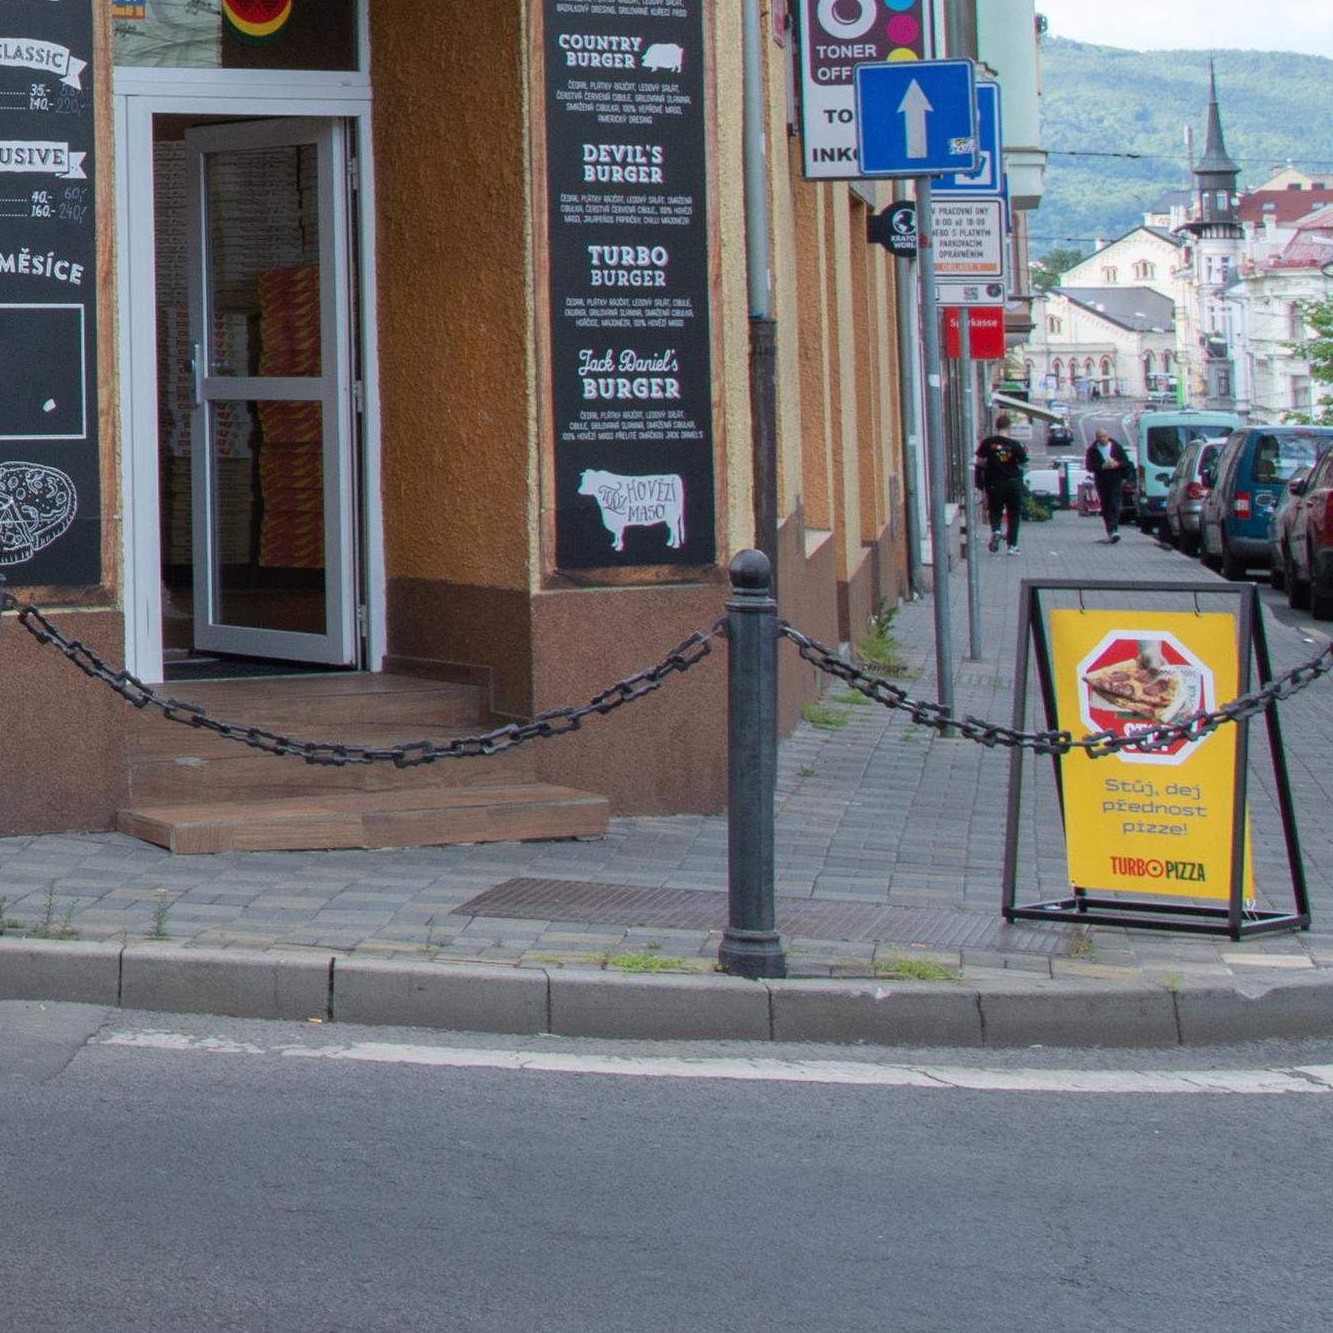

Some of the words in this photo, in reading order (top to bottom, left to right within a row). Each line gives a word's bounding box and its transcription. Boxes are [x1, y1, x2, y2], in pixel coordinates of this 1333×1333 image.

[557, 33, 643, 53] COUNTRY
[815, 43, 878, 59] TONER
[565, 51, 637, 69] BURGER
[582, 143, 664, 165] DEVIL'S
[583, 165, 664, 185] BURGER
[938, 206, 973, 216] PRACOVNÍ
[974, 207, 990, 216] DNY
[890, 234, 916, 242] KRATO
[587, 245, 669, 268] TURBO
[590, 269, 667, 288] BURGER
[949, 317, 998, 328] Spkasse
[578, 349, 616, 376] Jack
[618, 348, 679, 374] Daniel's
[583, 378, 681, 400] BURGER
[626, 478, 677, 503] HOVĚZÍ
[628, 504, 666, 523] MASO
[1164, 782, 1202, 800] dej
[1102, 799, 1208, 818] přednost
[1122, 821, 1189, 837] pizze!
[1109, 855, 1165, 879] TURBO
[1165, 859, 1206, 882] PIZZA
